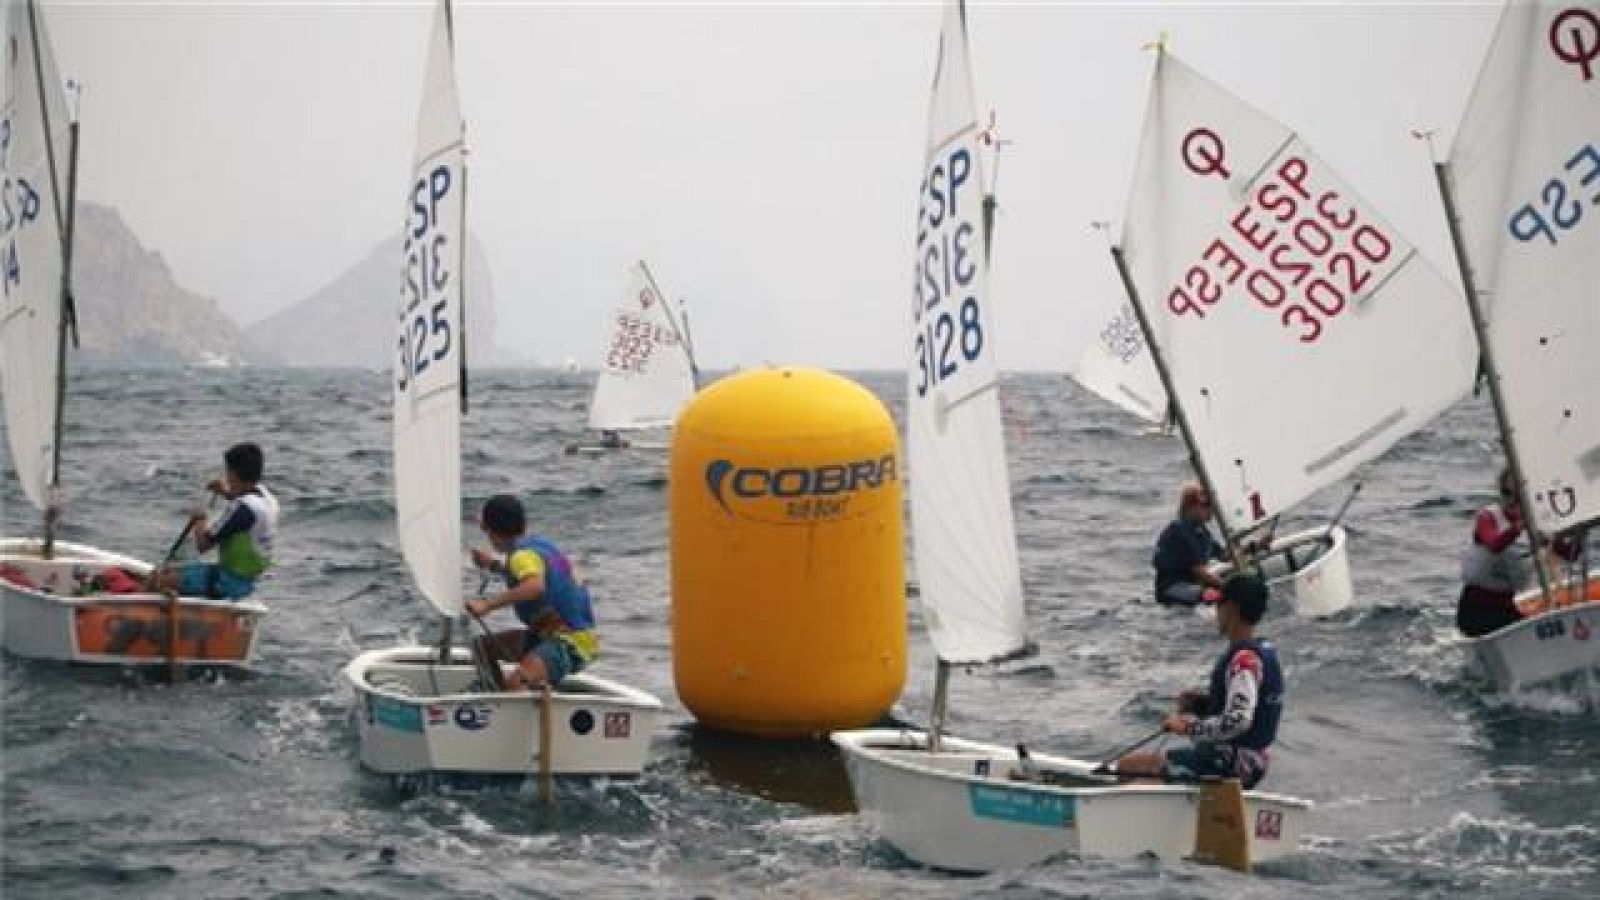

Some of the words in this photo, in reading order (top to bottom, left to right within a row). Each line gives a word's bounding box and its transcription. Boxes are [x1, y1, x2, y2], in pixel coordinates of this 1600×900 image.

[1231, 157, 1311, 251] ESP
[1282, 224, 1392, 342] 3020
[916, 296, 983, 397] 3128
[733, 454, 896, 498] COBRA
